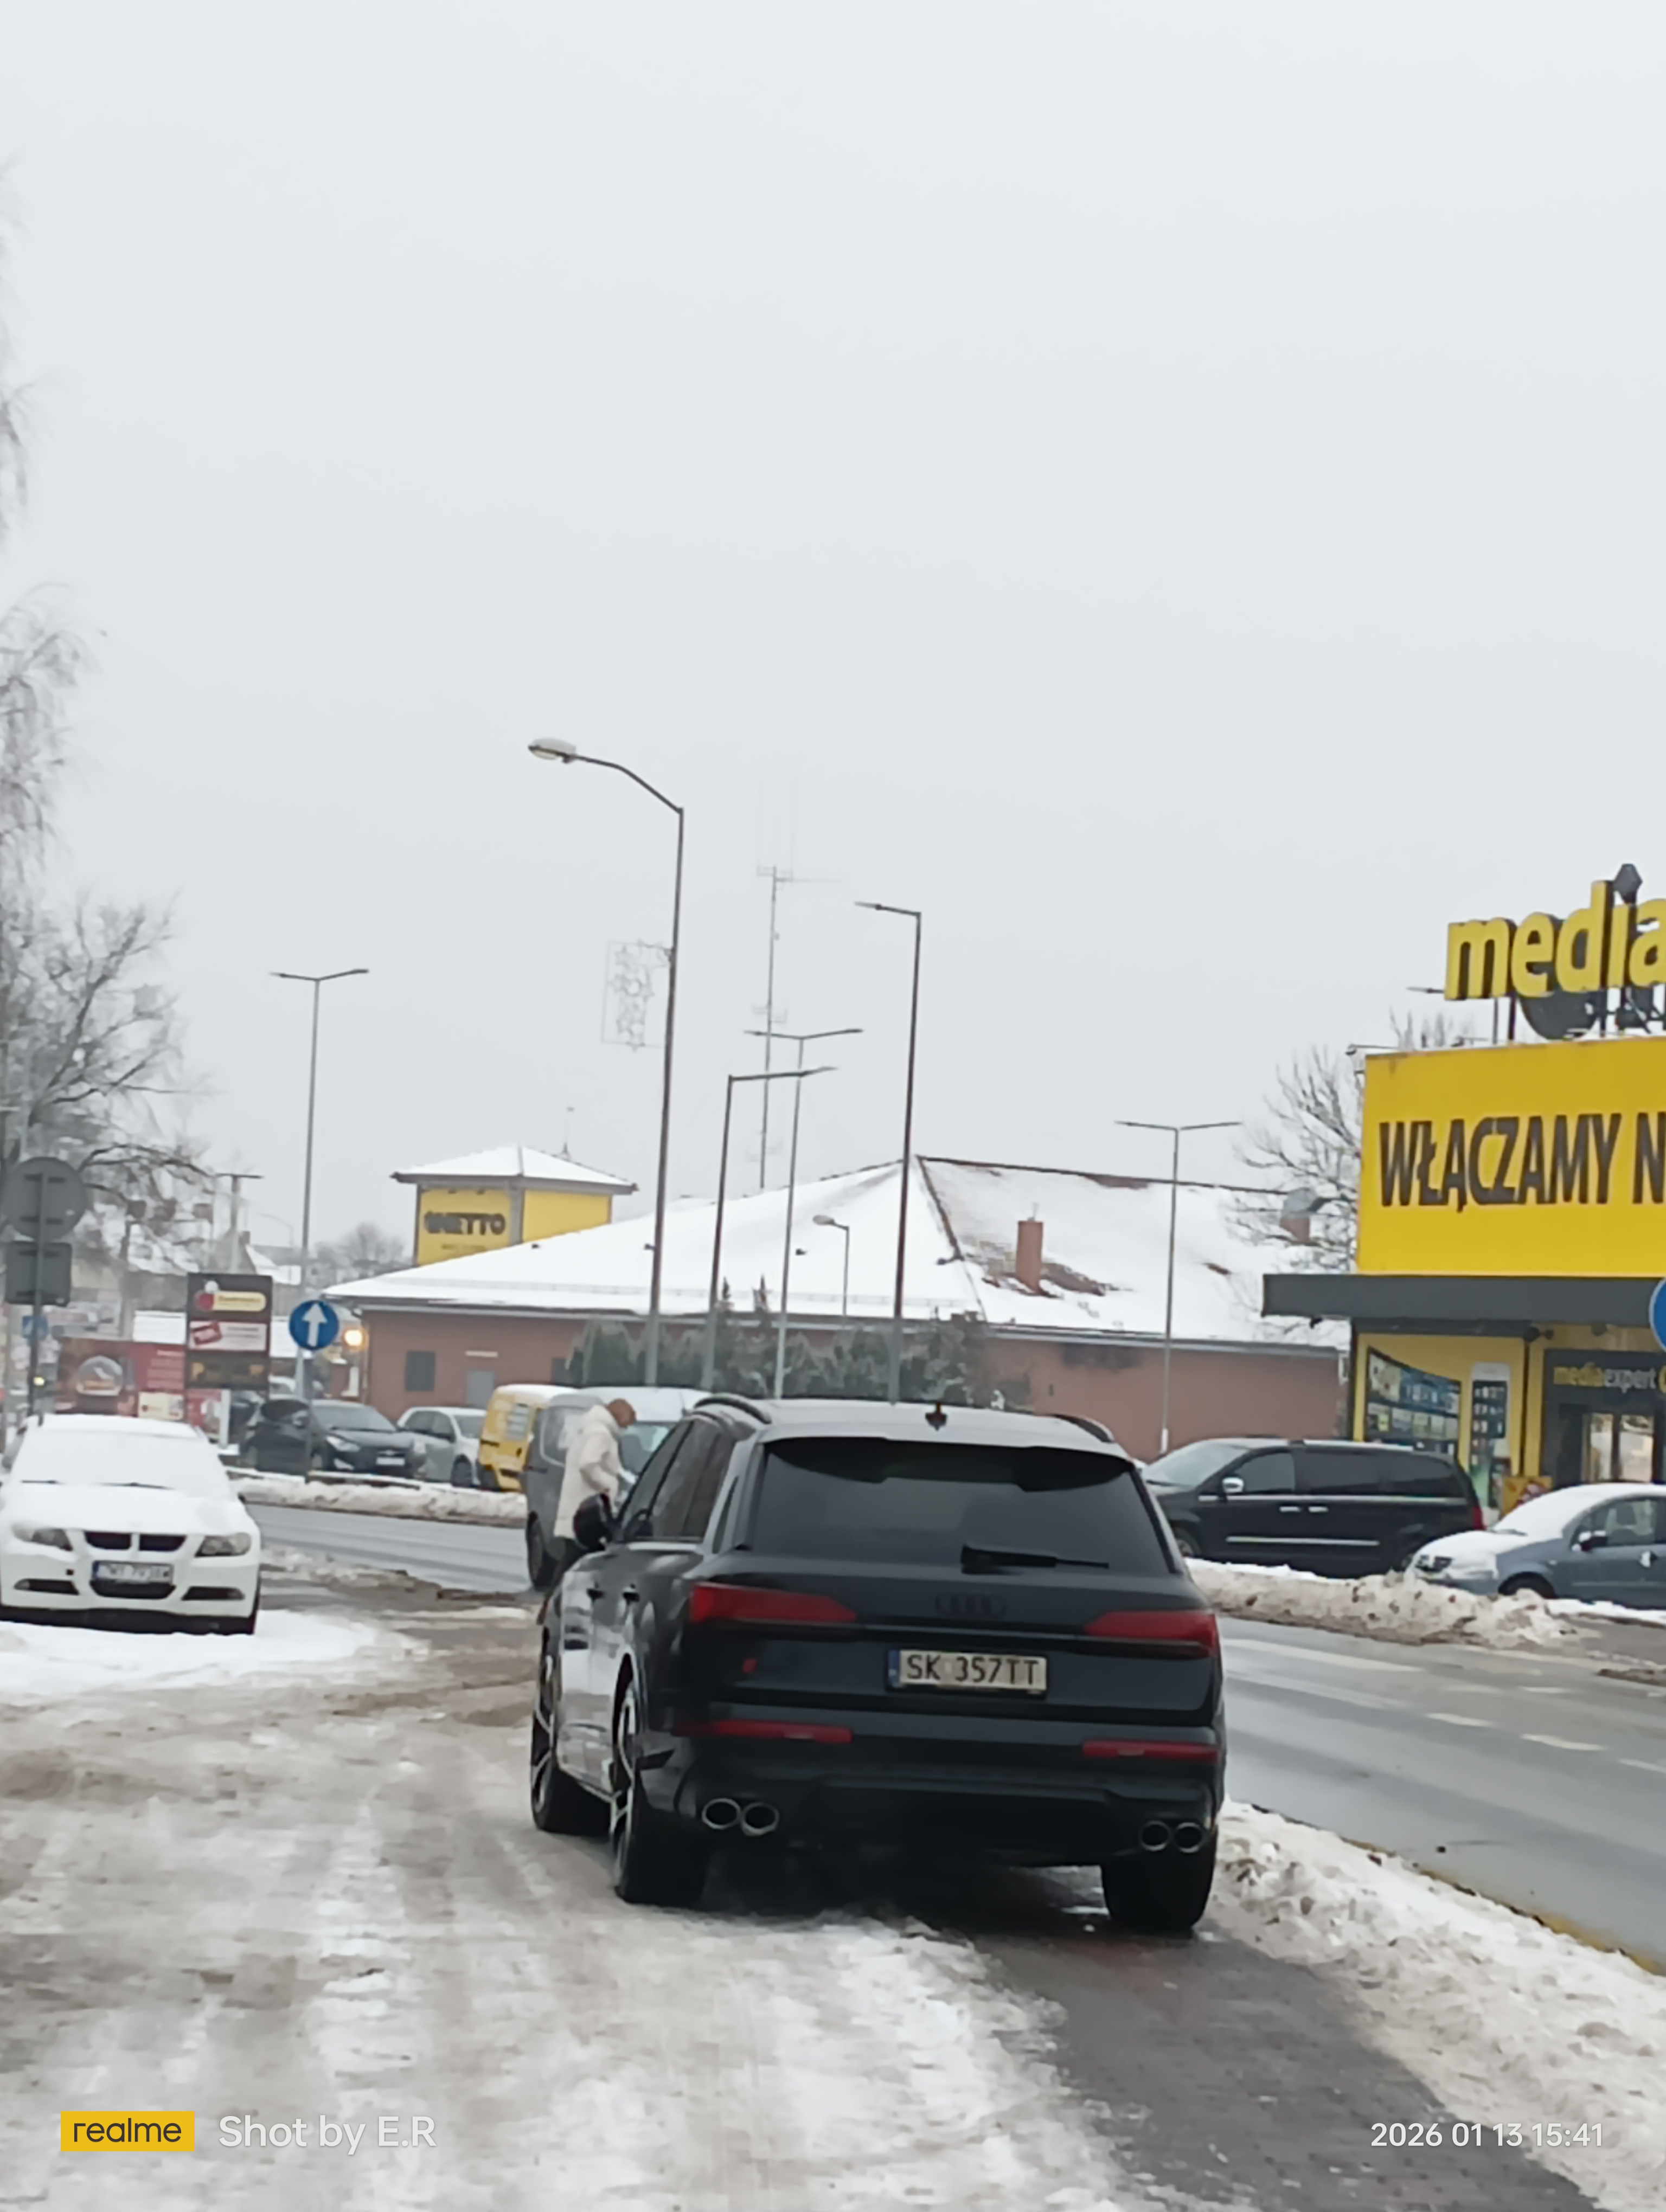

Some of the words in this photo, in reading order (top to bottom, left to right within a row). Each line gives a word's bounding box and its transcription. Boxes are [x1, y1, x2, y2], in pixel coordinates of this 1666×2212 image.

[1444, 865, 1666, 1001] media
[1379, 1113, 1620, 1213] WŁĄCZAMY
[906, 1654, 941, 1680] SK
[955, 1656, 1039, 1685] 357TT
